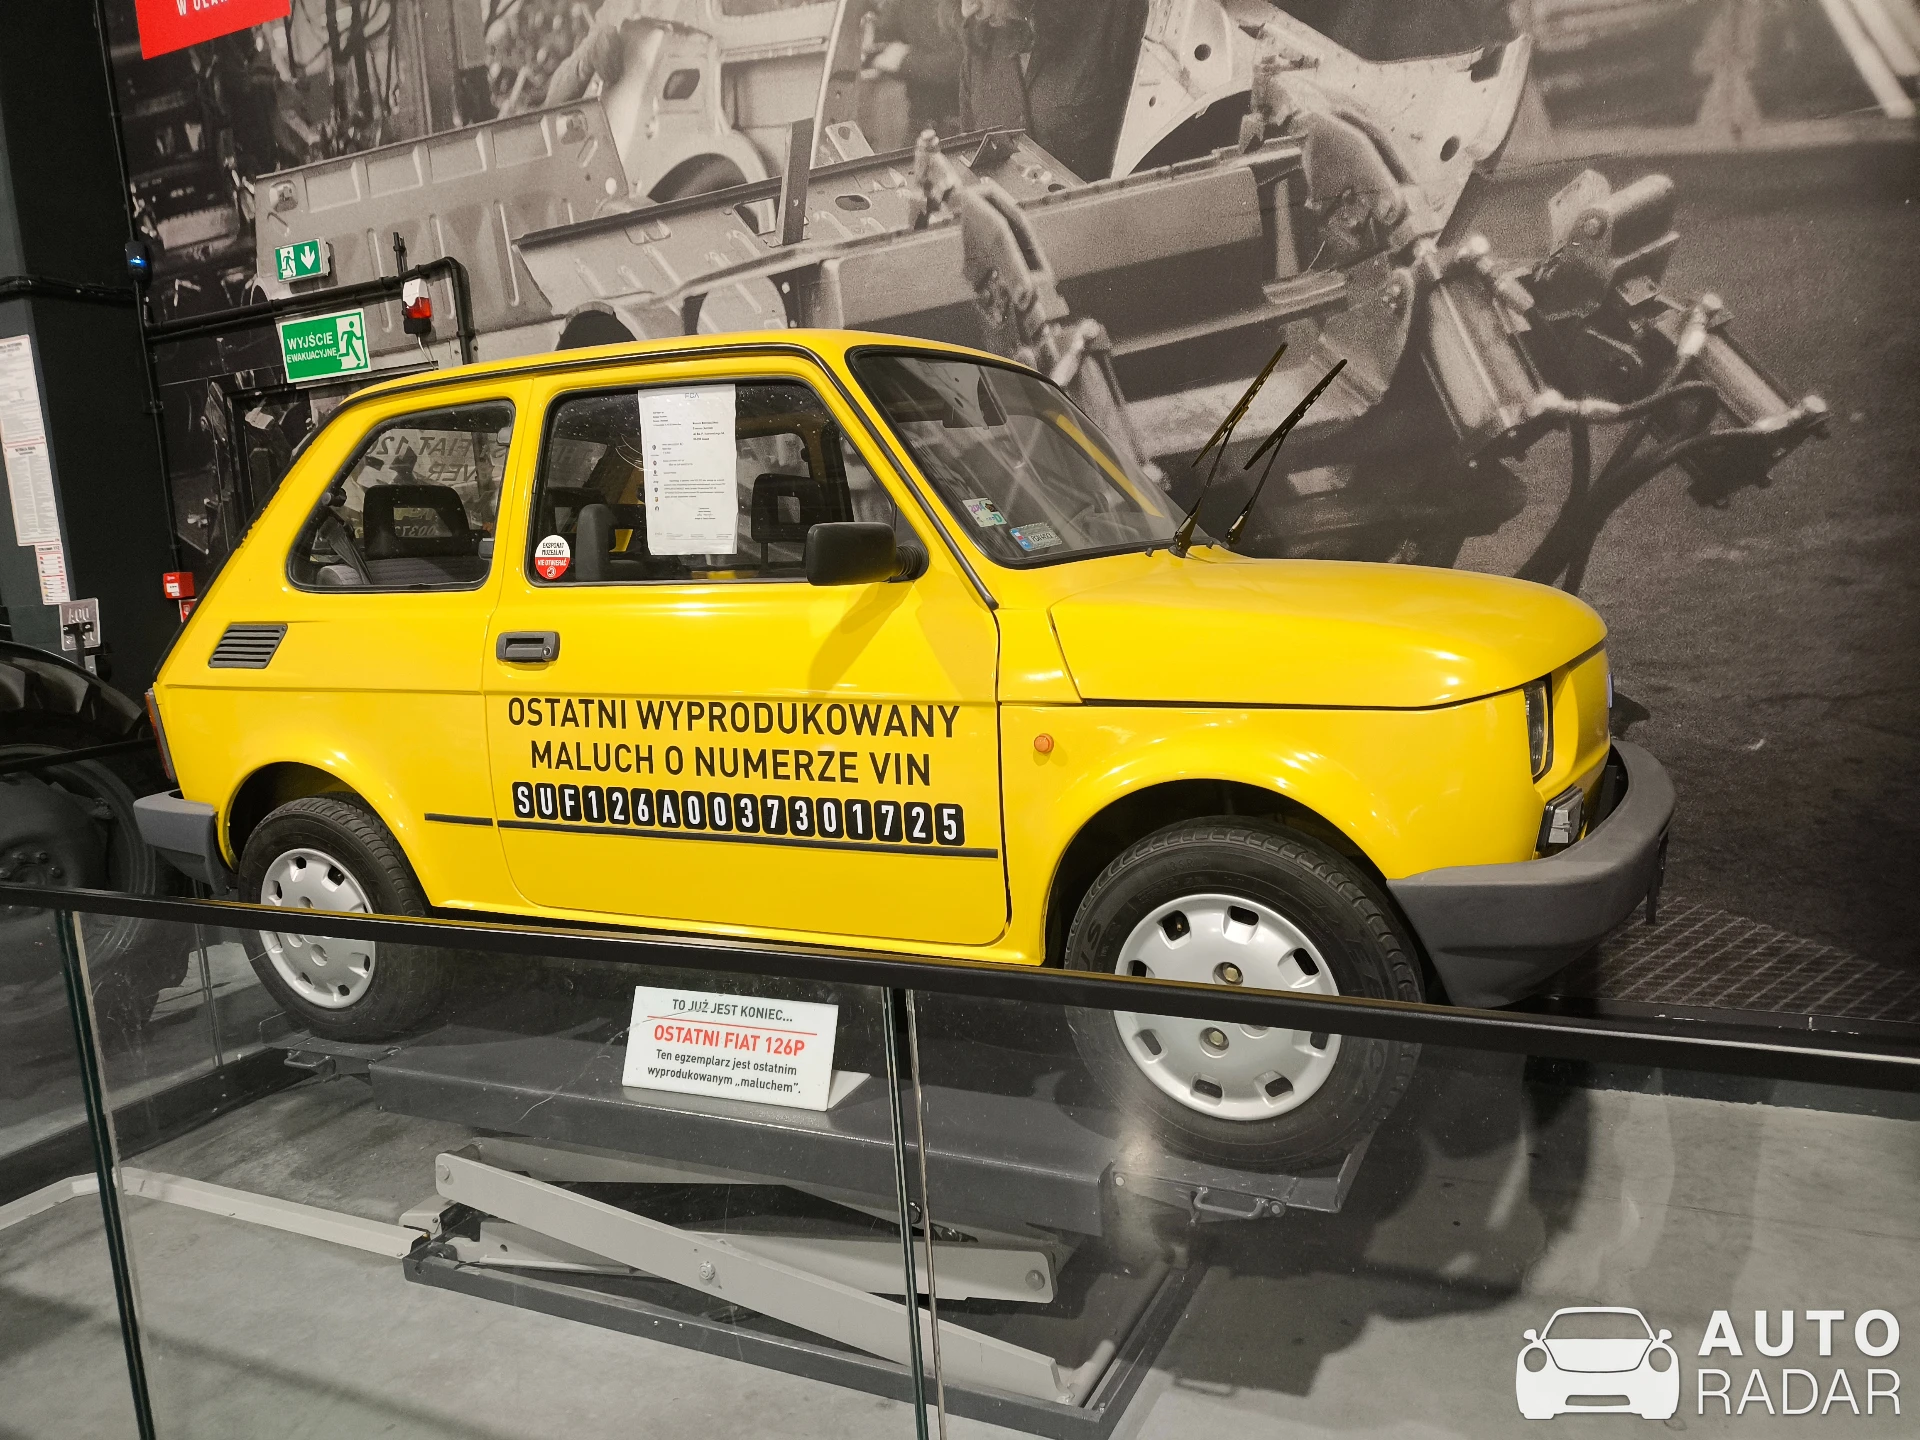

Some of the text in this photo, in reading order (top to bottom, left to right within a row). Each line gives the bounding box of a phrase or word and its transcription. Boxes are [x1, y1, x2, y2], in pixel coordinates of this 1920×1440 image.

[287, 332, 334, 350] WYJŚCIE
[286, 347, 338, 363] EWAKUACYJNE
[508, 697, 960, 738] OSTATNI WYPRODUKOWANY
[531, 740, 931, 787] MALUCH O NUMERZE VIN
[515, 784, 960, 842] SUF126A0037301725
[673, 999, 793, 1022] TO JUŻ JEST KONIEC...
[654, 1024, 805, 1057] OSTATNI FIAT 126P
[647, 1065, 733, 1085] wyprodukowanym
[656, 1049, 797, 1076] Ten egzemplarz jest ostatnim
